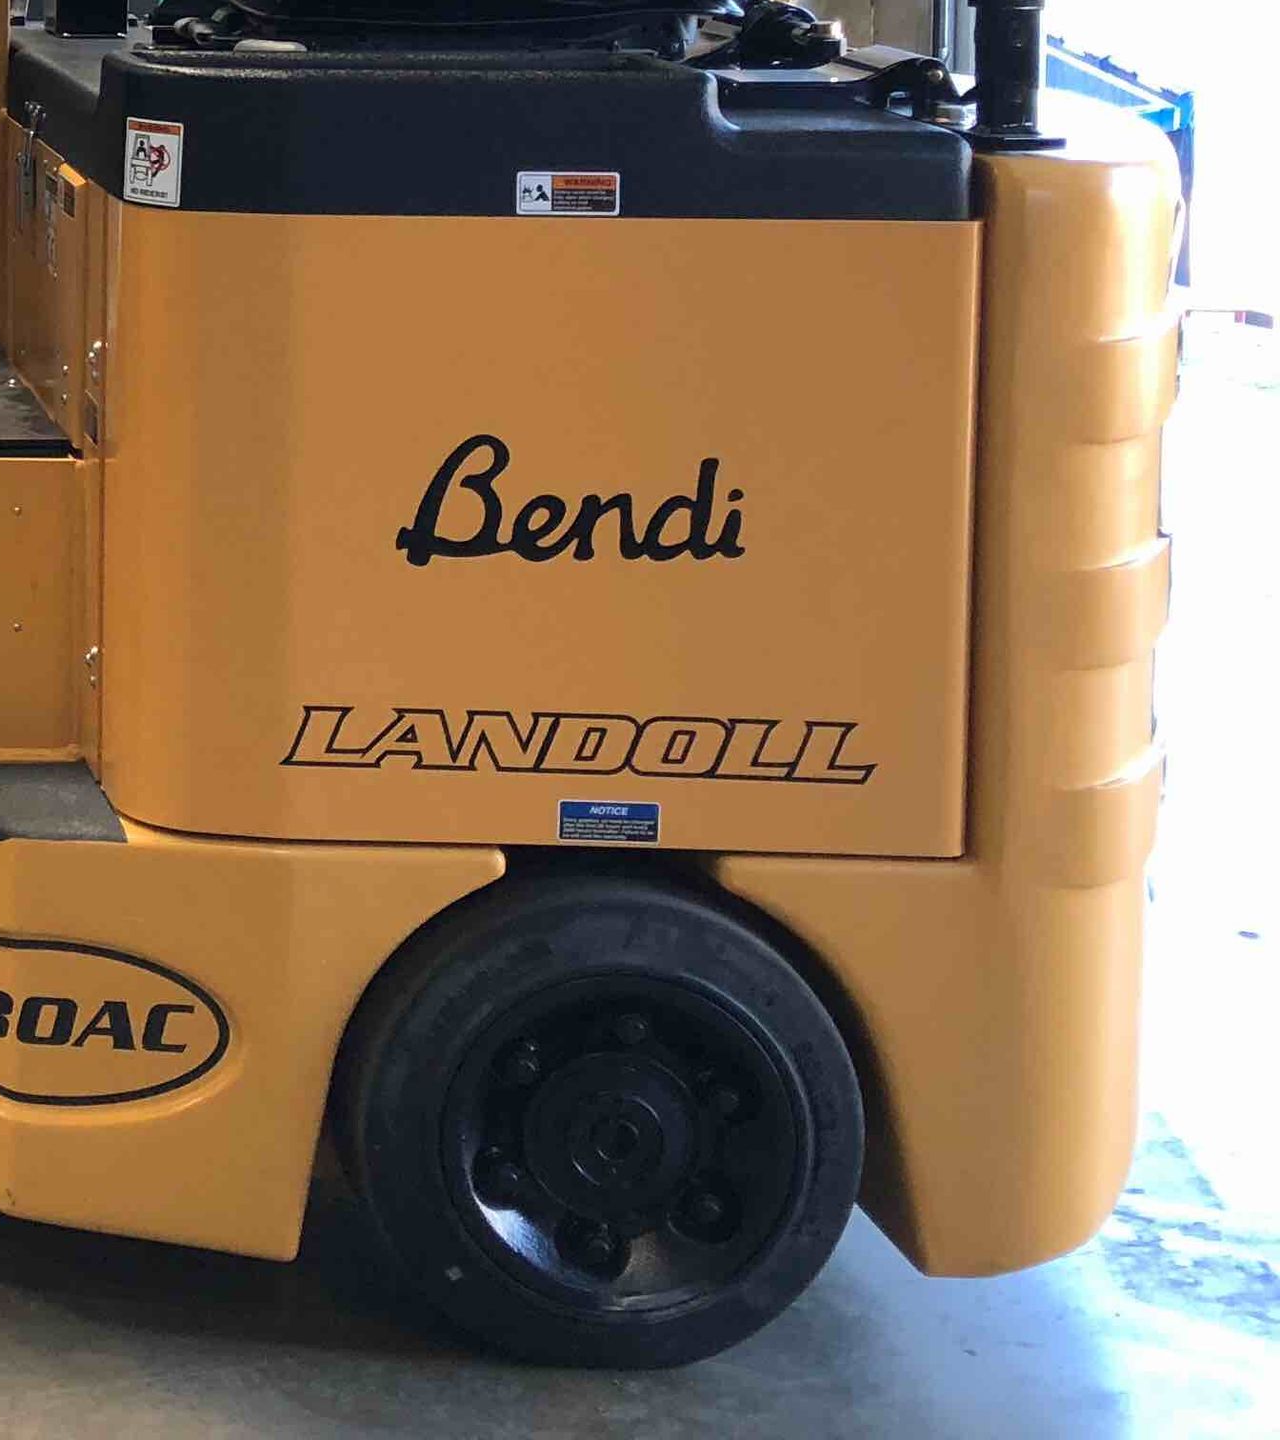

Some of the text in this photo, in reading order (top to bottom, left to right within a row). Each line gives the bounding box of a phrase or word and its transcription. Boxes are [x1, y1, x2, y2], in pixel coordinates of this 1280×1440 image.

[396, 433, 746, 566] Bendi
[279, 705, 878, 785] LANDOLL
[589, 806, 629, 816] NOTICE
